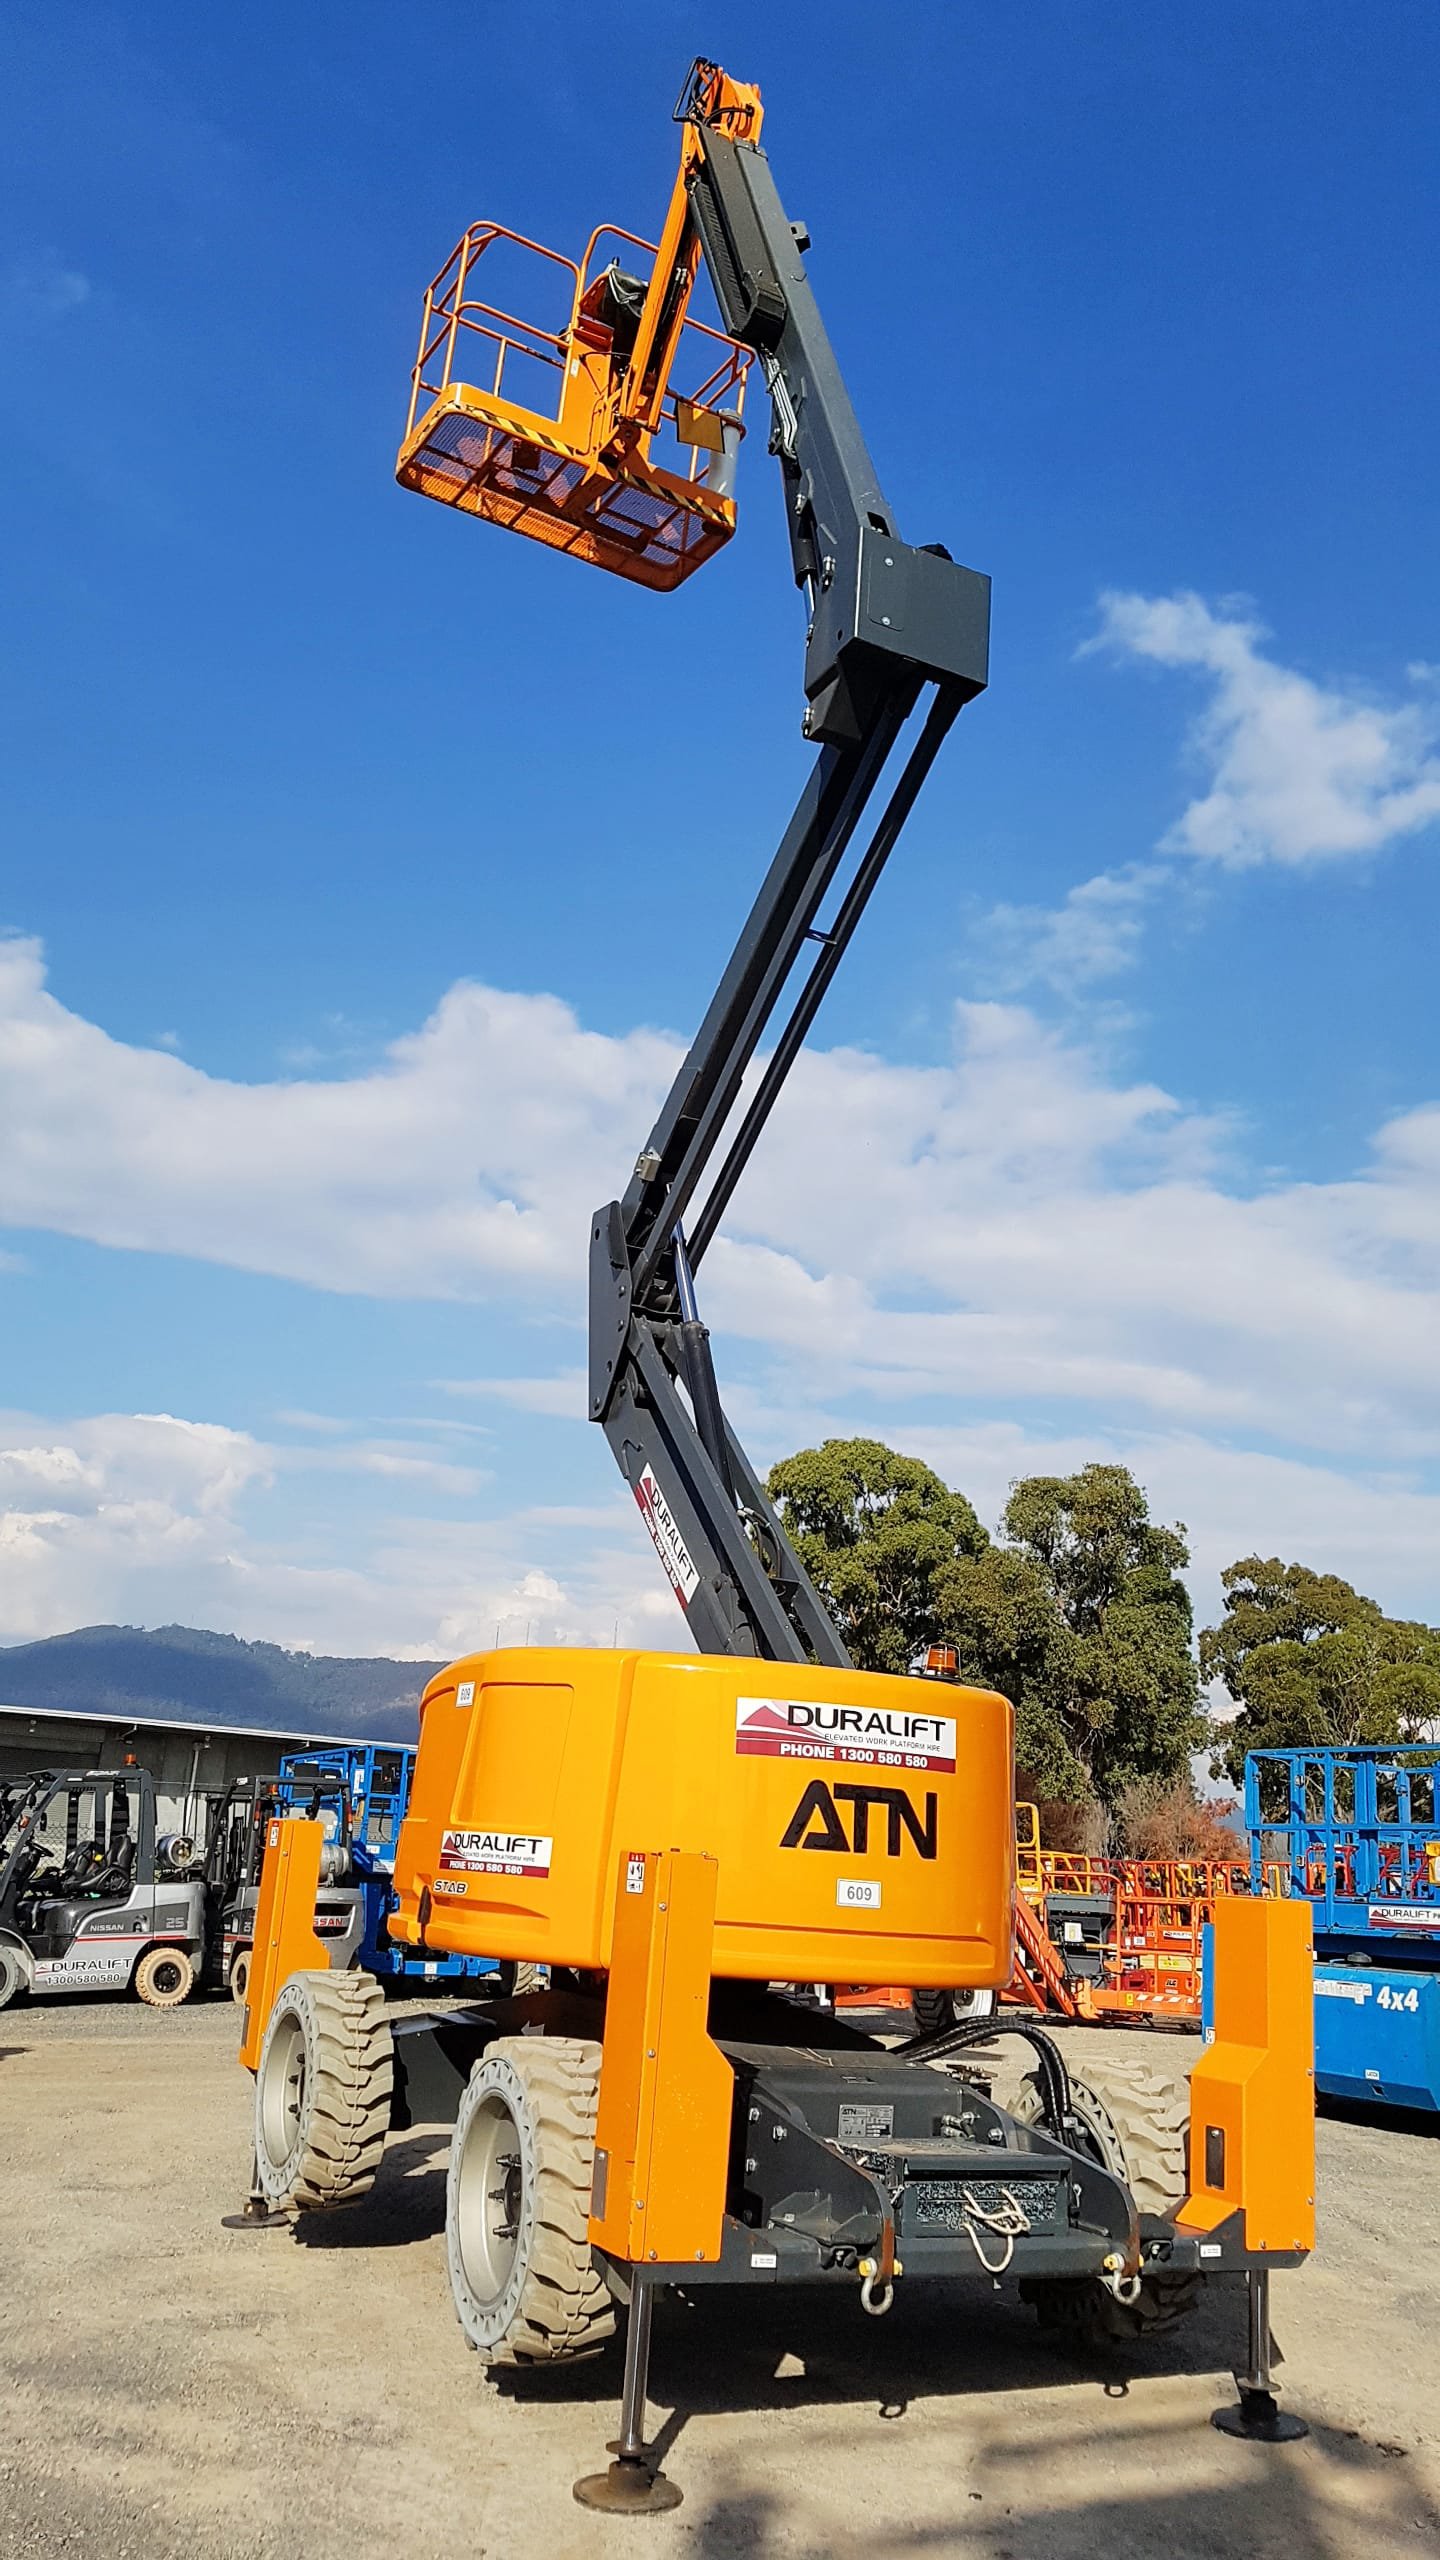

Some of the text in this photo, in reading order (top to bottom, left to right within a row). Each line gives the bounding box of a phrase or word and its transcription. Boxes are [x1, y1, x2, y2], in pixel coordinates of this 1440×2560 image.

[651, 1487, 695, 1581] DURALIFT
[787, 1704, 946, 1742] DURALIFT
[824, 1733, 864, 1743] ELEVATED
[866, 1736, 888, 1746] WORK
[889, 1739, 926, 1750] PLATFORM
[780, 1743, 928, 1769] PHONE 1300 580 580
[779, 1779, 938, 1860] ATN
[454, 1833, 543, 1855] DURALIFT
[467, 1861, 484, 1871] 1300
[486, 1863, 503, 1873] 580
[504, 1865, 523, 1875] 580
[434, 1880, 467, 1894] STAB
[847, 1885, 873, 1901] 609
[1381, 1908, 1431, 1919] DURALIFT
[89, 1923, 124, 1932] NISSAN
[166, 1917, 185, 1929] 25
[313, 1917, 343, 1928] SSAN
[51, 1958, 133, 1973] DURALIFT
[46, 1973, 120, 1985] 1300 580 580
[1376, 1985, 1420, 2013] 4x4
